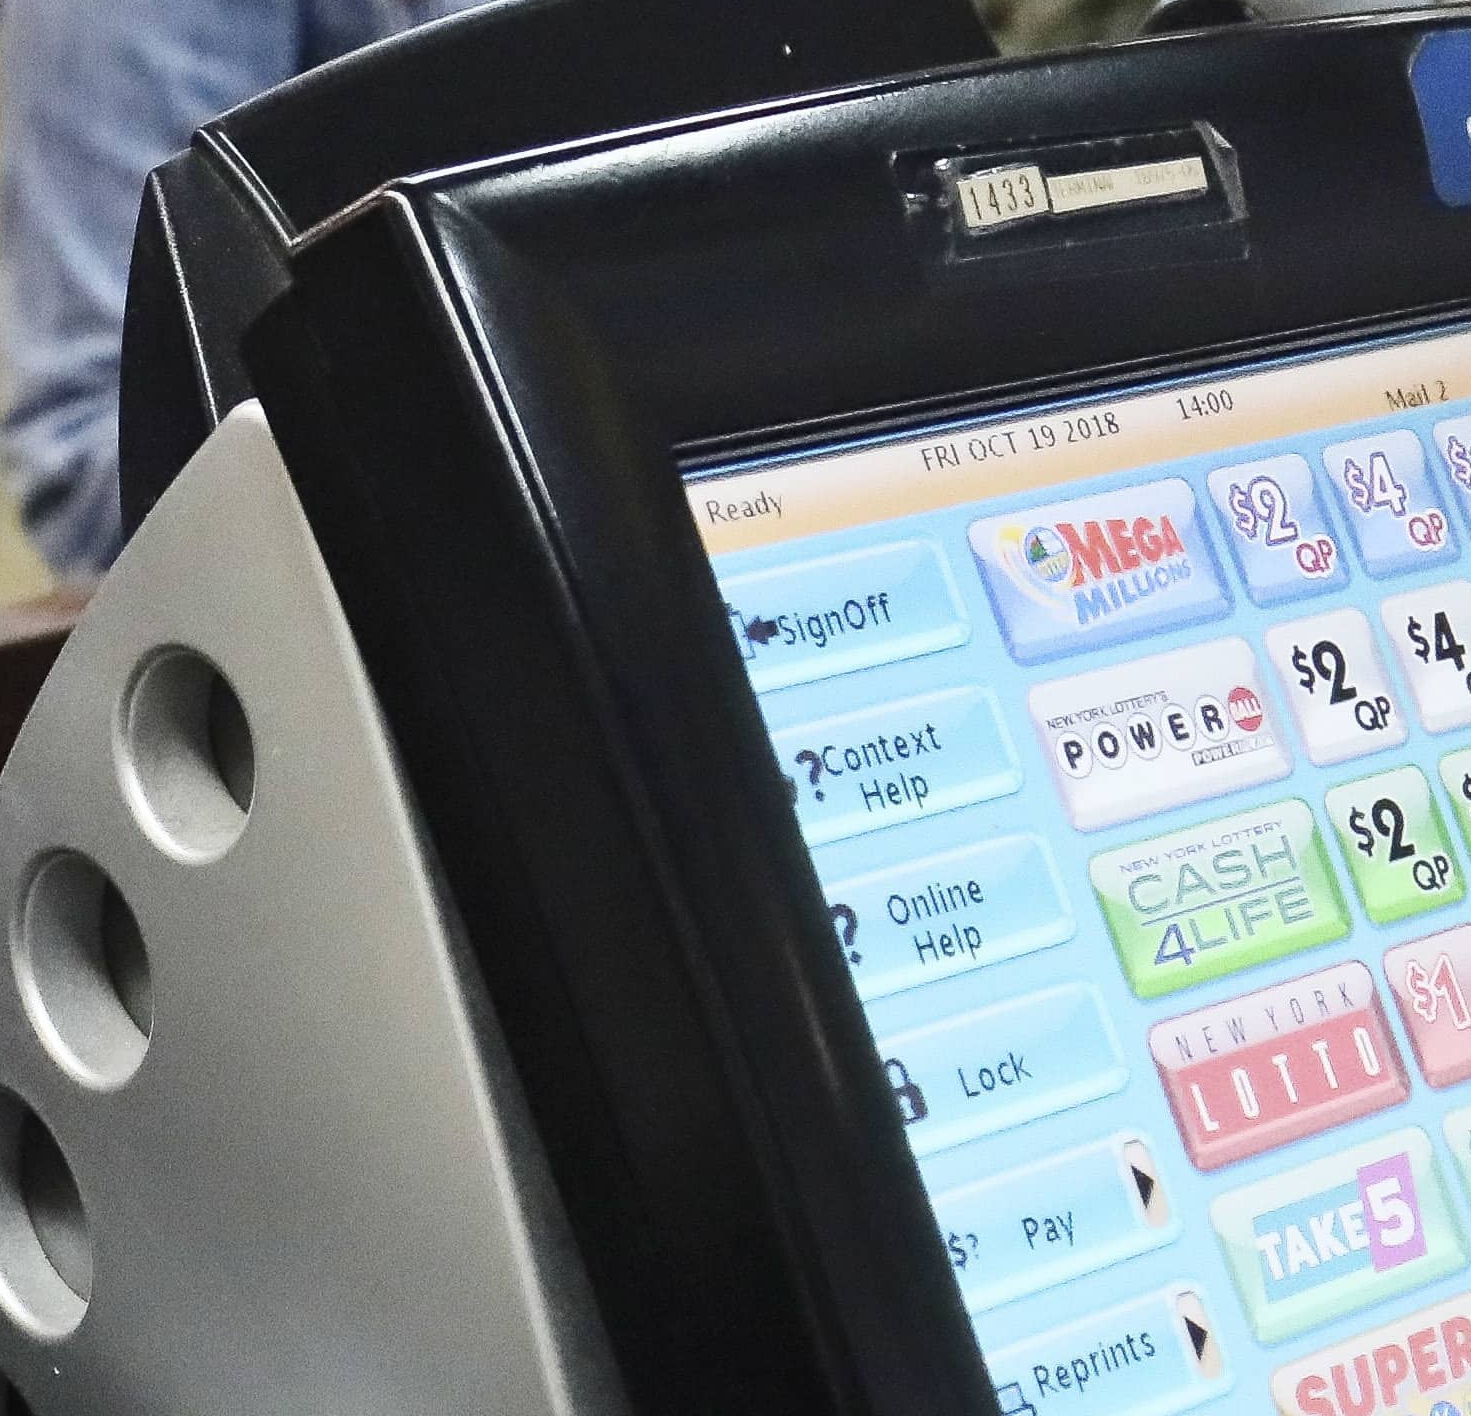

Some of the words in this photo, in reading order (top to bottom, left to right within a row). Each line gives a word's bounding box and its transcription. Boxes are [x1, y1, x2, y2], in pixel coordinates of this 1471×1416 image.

[970, 174, 1034, 220] 1433
[1177, 388, 1234, 420] 14:00
[1385, 386, 1432, 410] Mail
[1434, 380, 1449, 404] 2
[921, 442, 960, 472] FRI
[968, 431, 1018, 465] OCT
[1028, 426, 1056, 451] 19
[1067, 412, 1120, 445] 2018
[706, 491, 783, 525] Ready
[1343, 451, 1407, 515] $4
[1228, 475, 1298, 548] $2
[1408, 510, 1444, 547] QP
[1055, 515, 1185, 588] MEGA
[1296, 539, 1335, 577] QP
[1073, 558, 1193, 625] MILLIONS
[779, 593, 892, 648] SignOff
[1407, 611, 1466, 673] $4
[1293, 640, 1358, 707] $2
[1062, 703, 1224, 769] POWER
[1354, 694, 1391, 732] QP
[823, 723, 942, 777] Context
[860, 773, 929, 813] Help
[1119, 855, 1157, 874] NEW
[1163, 841, 1203, 863] YORK
[1210, 819, 1284, 849] LOTTERY
[1349, 797, 1415, 863] $2
[1127, 835, 1299, 916] CASH
[1413, 854, 1450, 891] QP
[886, 878, 985, 927] Online
[914, 923, 983, 965] Help
[1175, 1015, 1247, 1060] NEW
[1263, 980, 1355, 1032] YORK
[958, 1052, 1033, 1099] Lock
[1189, 1027, 1381, 1133] LOTTO
[1021, 1211, 1076, 1250] Pay
[1032, 1331, 1157, 1398] Reprints
